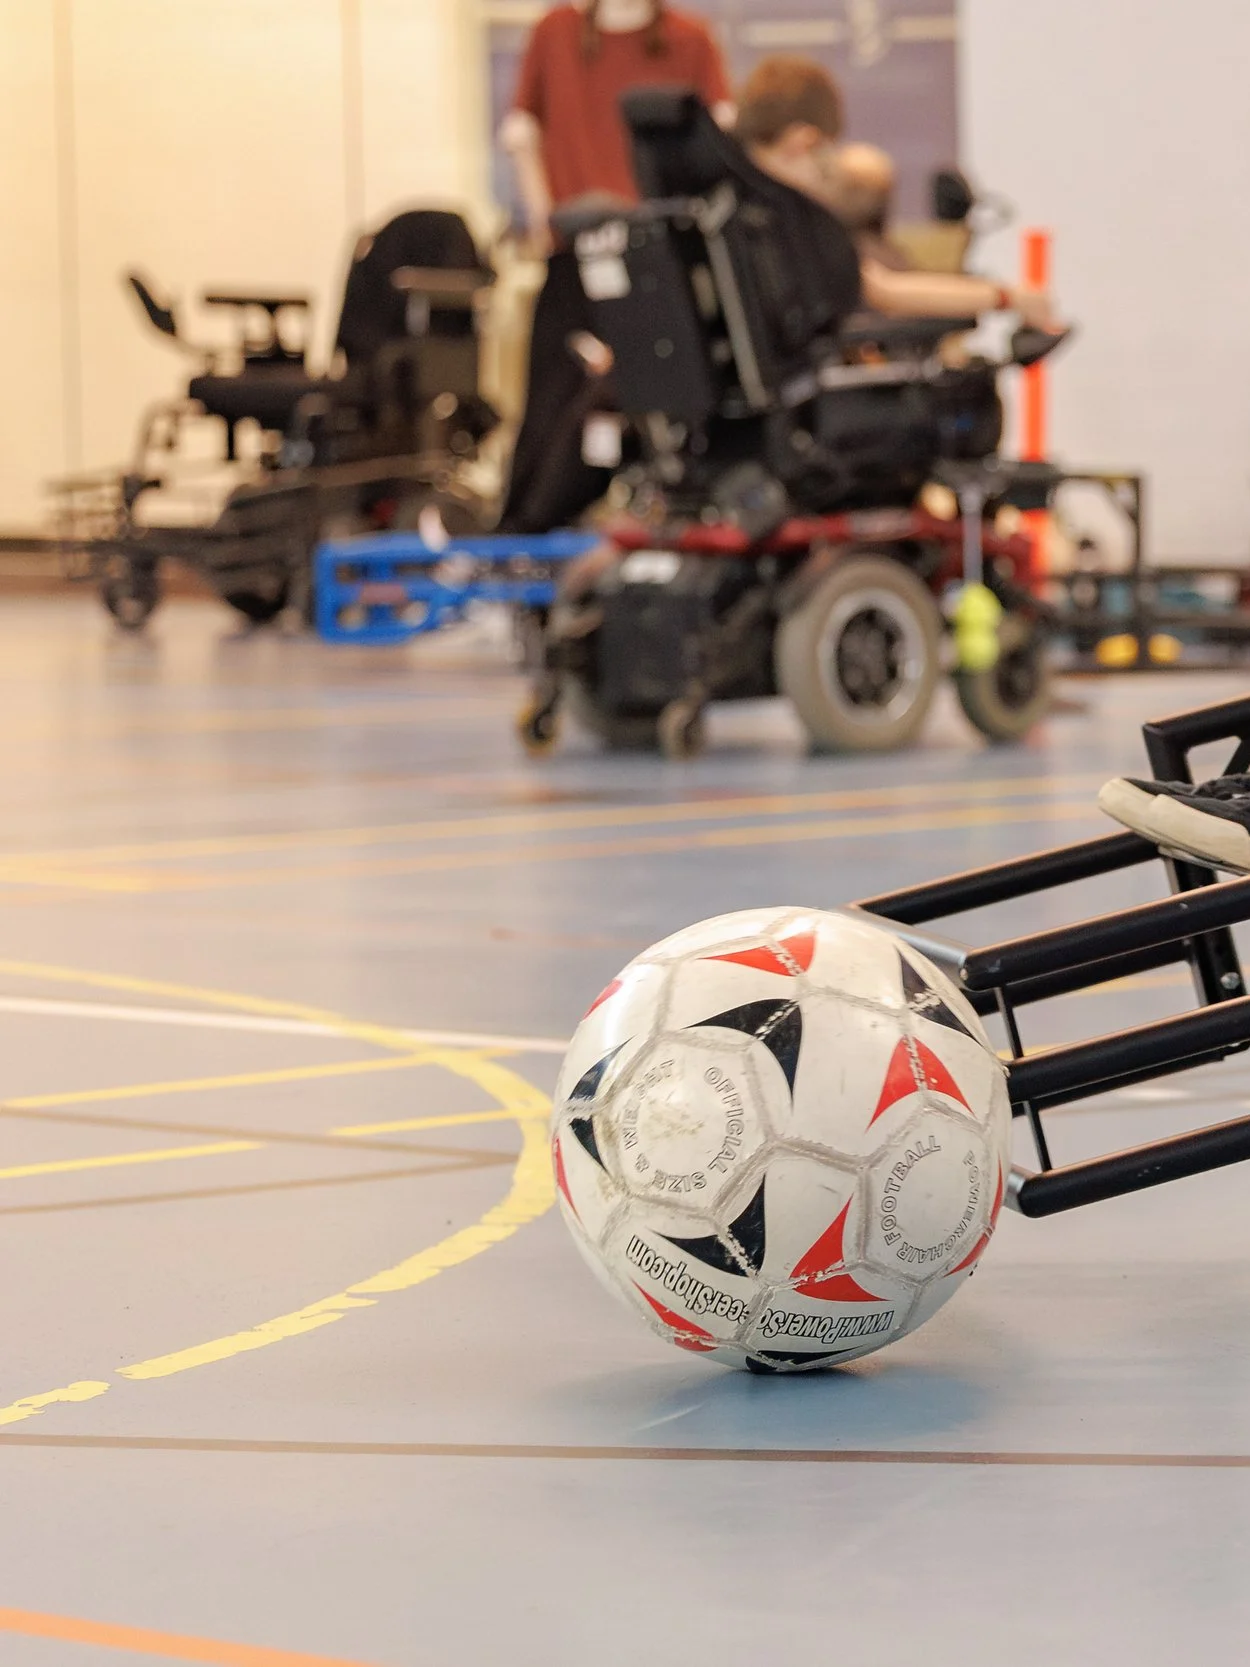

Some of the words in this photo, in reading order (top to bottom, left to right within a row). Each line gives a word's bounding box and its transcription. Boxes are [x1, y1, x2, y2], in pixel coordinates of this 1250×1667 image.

[703, 1066, 744, 1174] OFFICIAL
[651, 1169, 707, 1193] SIZE
[880, 1135, 941, 1246] FOOTBALL
